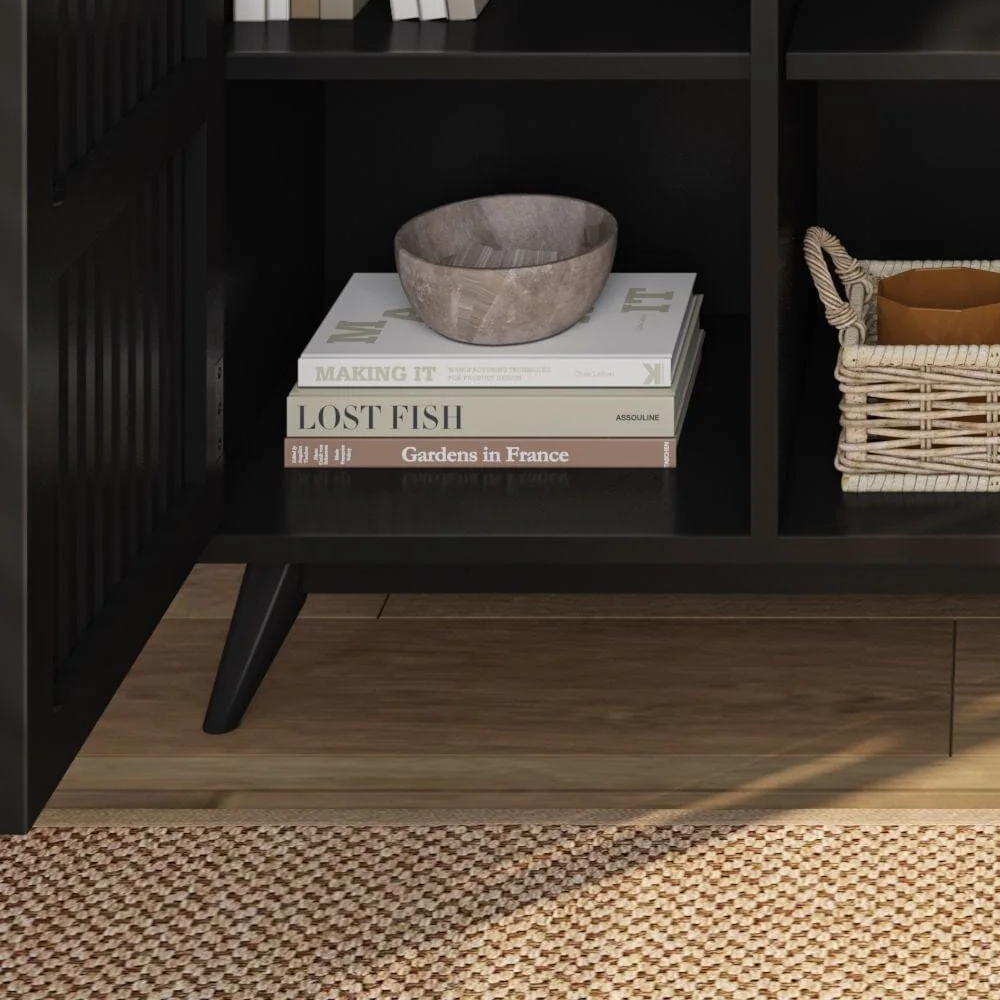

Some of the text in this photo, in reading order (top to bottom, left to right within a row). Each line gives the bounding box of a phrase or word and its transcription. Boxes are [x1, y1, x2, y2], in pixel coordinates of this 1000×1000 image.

[315, 366, 436, 382] MAKING IT
[298, 405, 464, 430] LOST FISH
[615, 414, 660, 422] ASSOULINE
[401, 446, 570, 463] Gardens in France
